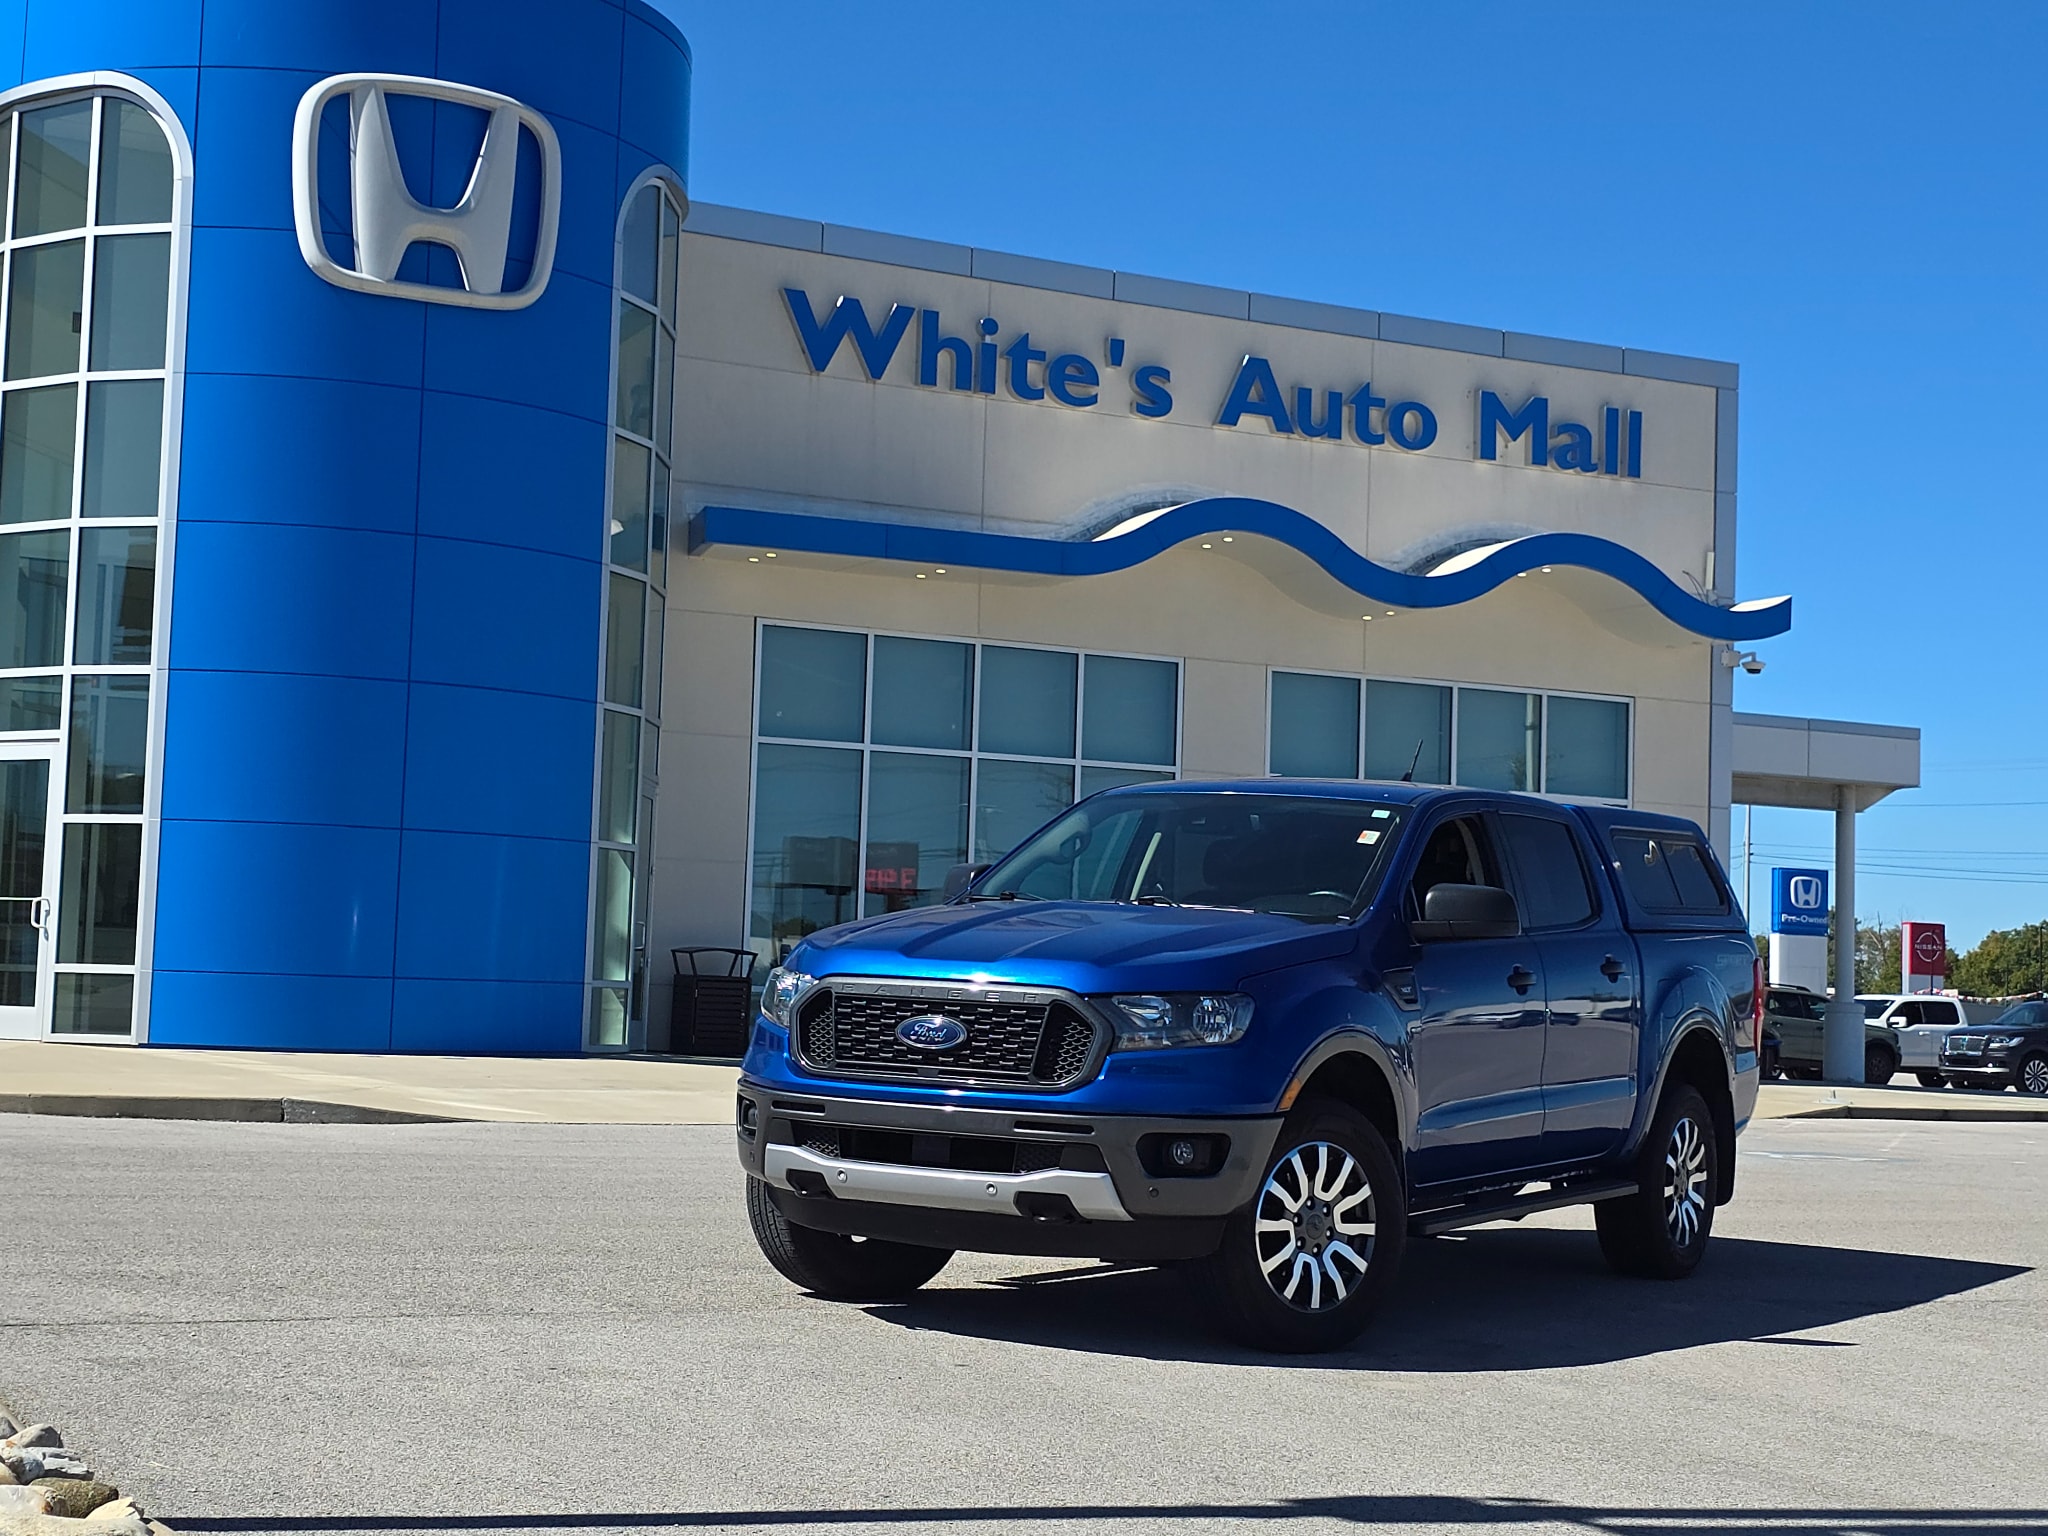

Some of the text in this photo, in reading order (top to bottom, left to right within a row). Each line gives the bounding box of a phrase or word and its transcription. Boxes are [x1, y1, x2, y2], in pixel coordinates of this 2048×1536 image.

[782, 286, 1642, 478] White's Auto Mall
[1781, 913, 1828, 924] Pre-Owned
[1914, 943, 1943, 951] NISSAN
[910, 1022, 947, 1041] Ford
